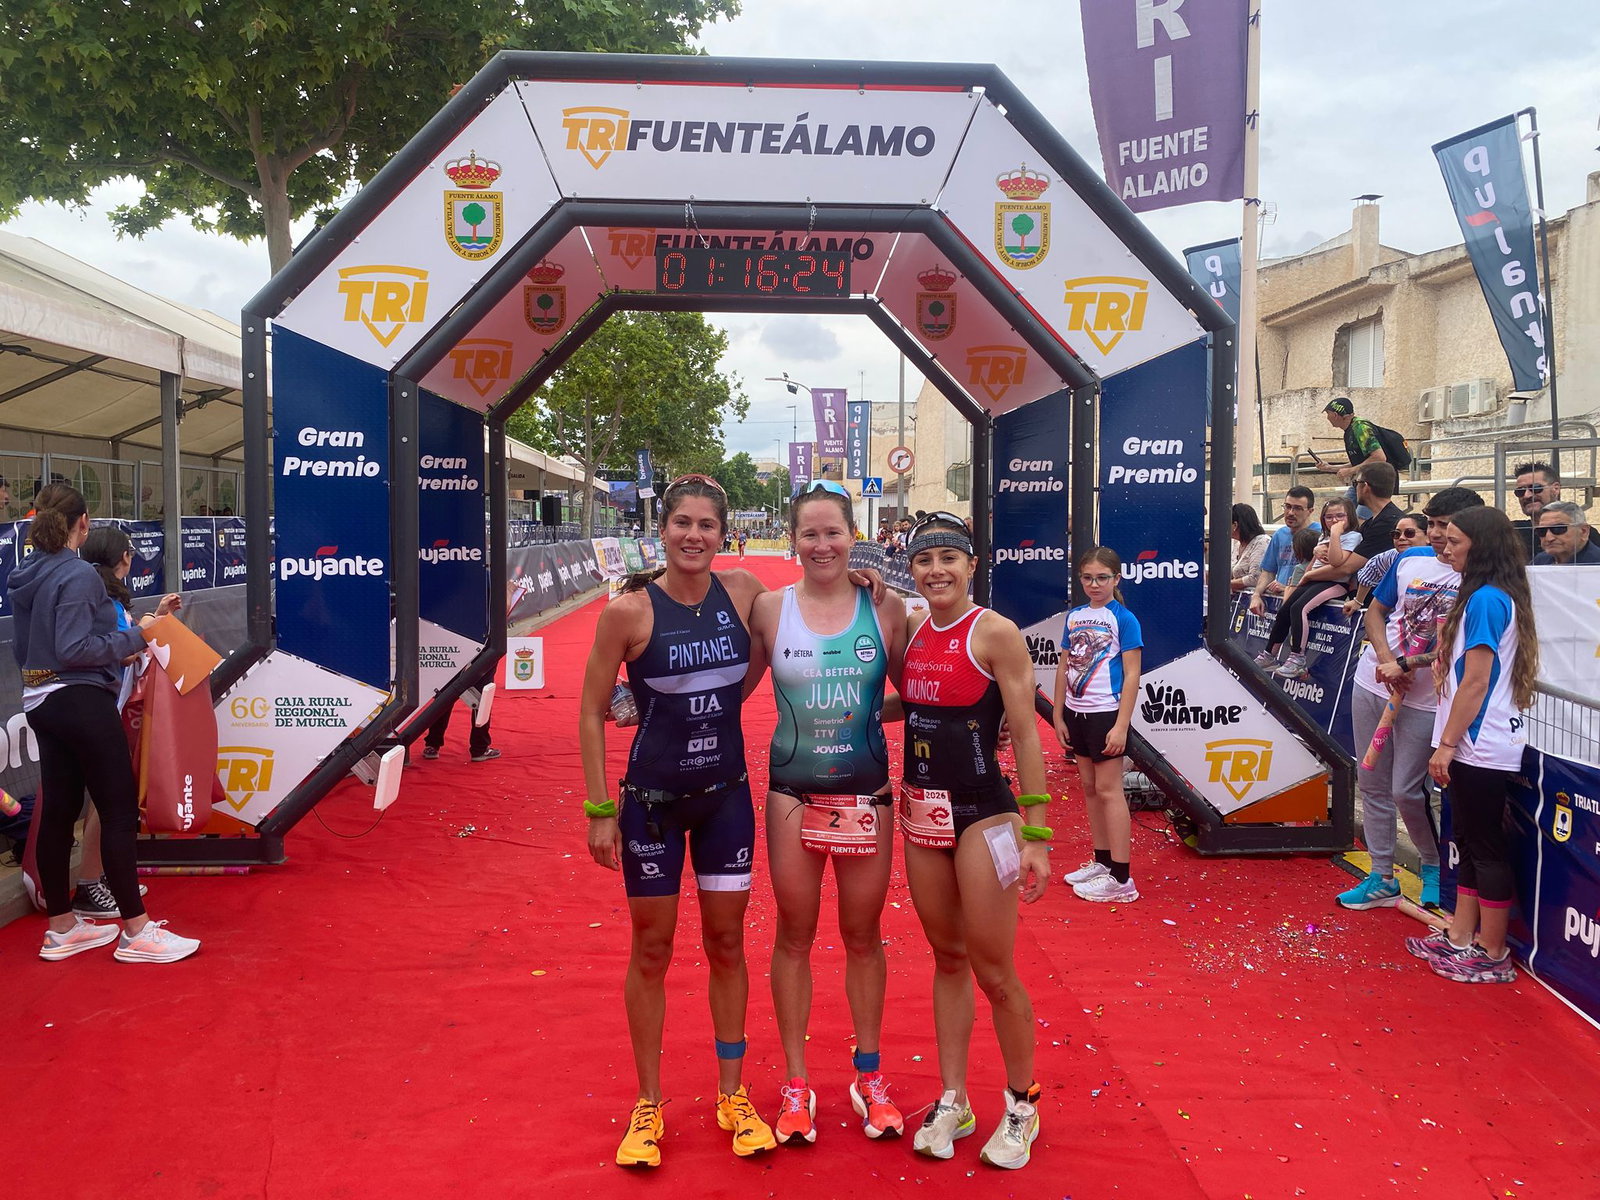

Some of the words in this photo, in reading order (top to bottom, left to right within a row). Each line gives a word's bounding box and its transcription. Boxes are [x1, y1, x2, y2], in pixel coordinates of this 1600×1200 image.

[1118, 126, 1208, 166] FUENTE
[1122, 162, 1209, 200] ALAMO
[338, 280, 429, 323] TRI
[1064, 291, 1148, 331] TRI
[449, 349, 513, 379] TRI
[966, 358, 1028, 385] TRI
[298, 427, 364, 447] Gran
[1123, 436, 1184, 456] Gran
[282, 454, 380, 477] Premio
[420, 454, 467, 469] Gran
[1009, 458, 1054, 472] Gran
[1108, 462, 1198, 484] Premio
[998, 477, 1064, 492] Premio
[996, 544, 1064, 564] pujante
[182, 567, 207, 583] ujante
[280, 549, 384, 581] pujante
[1120, 555, 1199, 584] ujante
[1316, 632, 1325, 641] VILLA
[1321, 621, 1352, 635] INTERNACIONAL
[669, 636, 738, 670] PINTANEL
[794, 649, 814, 658] BÉTERA
[803, 668, 823, 678] CEA
[825, 666, 863, 677] BÉTERA
[805, 681, 861, 710] JUAN
[906, 676, 940, 702] MUÑOZ
[274, 697, 305, 707] CAJA
[308, 697, 352, 707] RURAL
[688, 693, 722, 715] UA
[275, 708, 339, 717] REGIONAL
[275, 718, 292, 727] DE
[296, 718, 347, 727] MURCIA
[814, 729, 835, 738] ITV
[812, 744, 854, 754] JOVISA
[1204, 750, 1274, 782] TRI
[178, 774, 195, 830] ujante
[926, 792, 946, 800] 2026
[829, 811, 840, 828] 2
[830, 846, 856, 854] FUENTE
[857, 845, 876, 854] ÁLAMO
[929, 836, 952, 846] ÁLAMO
